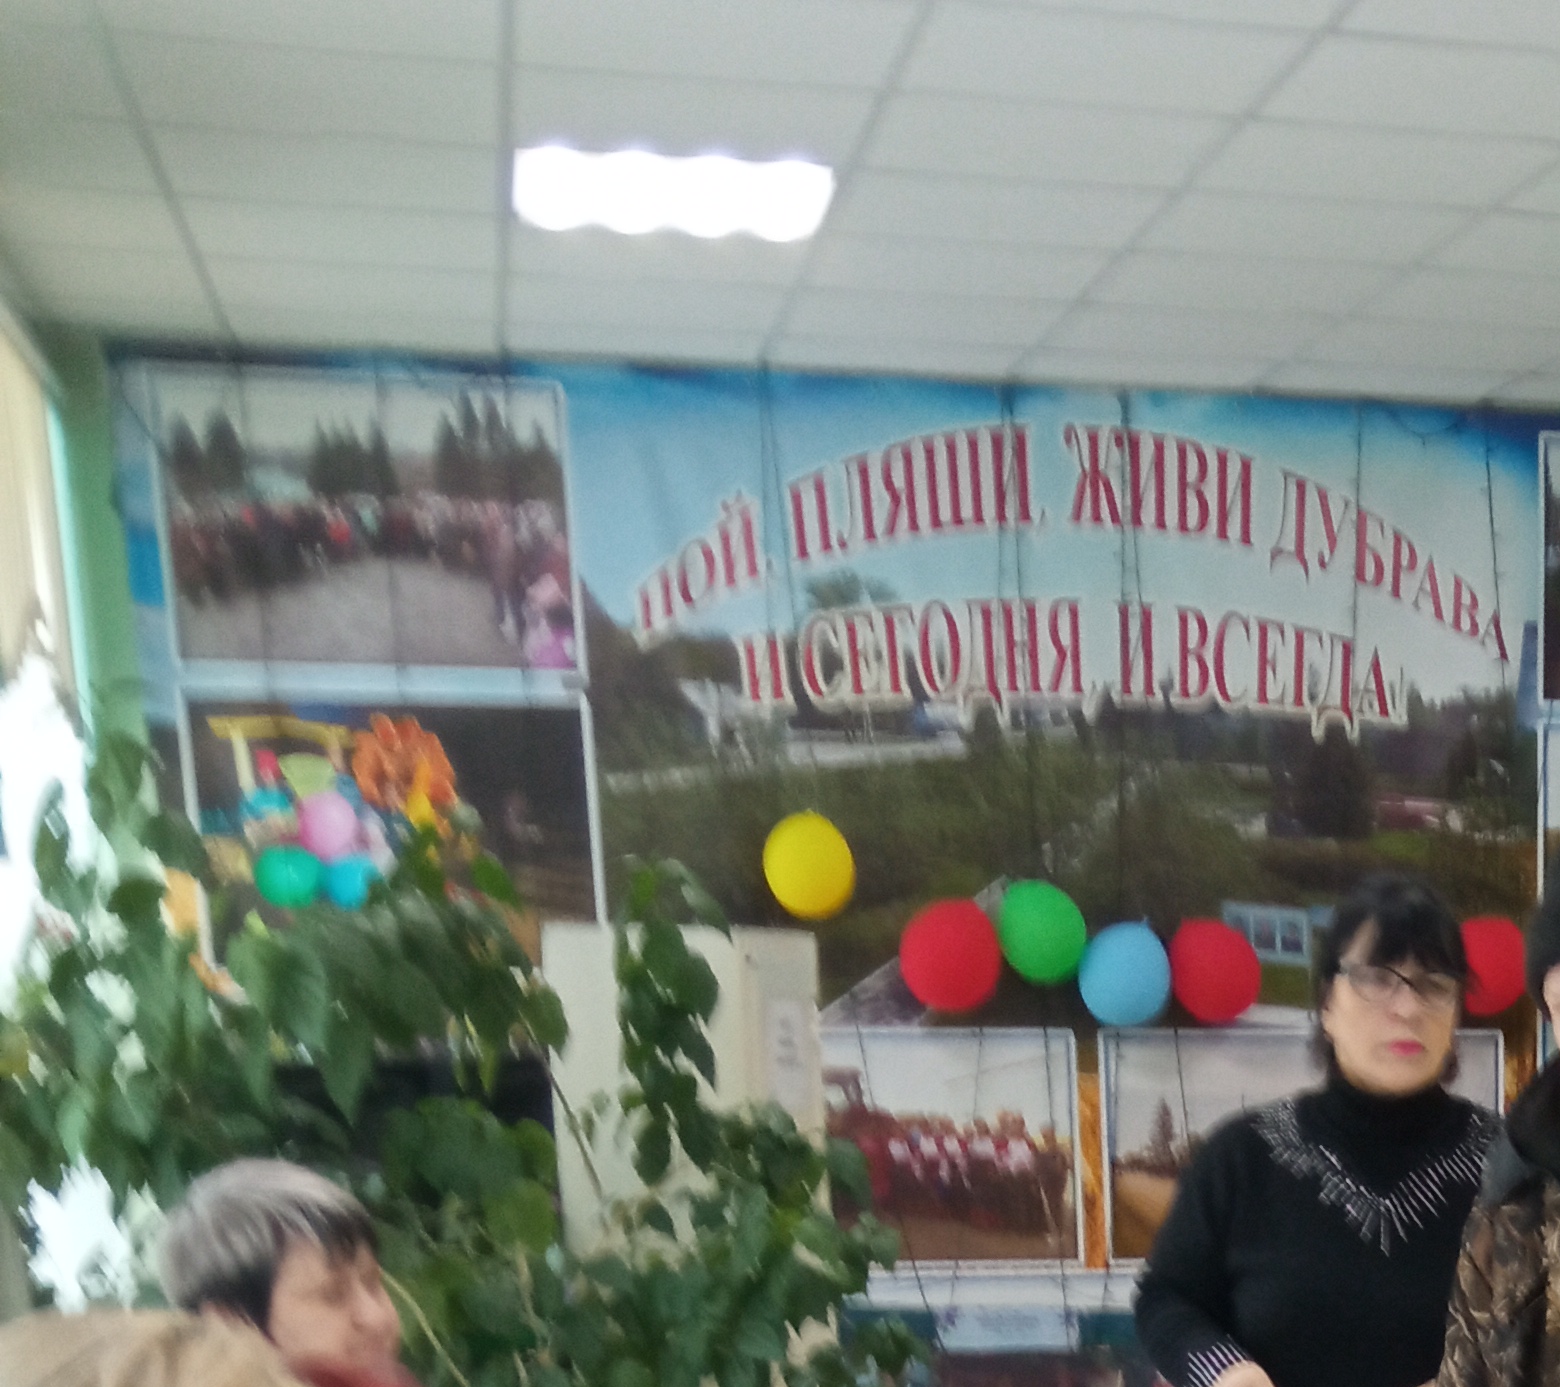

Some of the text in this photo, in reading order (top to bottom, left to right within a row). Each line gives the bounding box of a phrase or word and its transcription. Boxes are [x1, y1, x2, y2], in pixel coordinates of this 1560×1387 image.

[1063, 422, 1254, 547] ЖИВИ
[1268, 467, 1510, 665] ДУБРАВА
[742, 632, 785, 703] И
[1117, 600, 1155, 699] И
